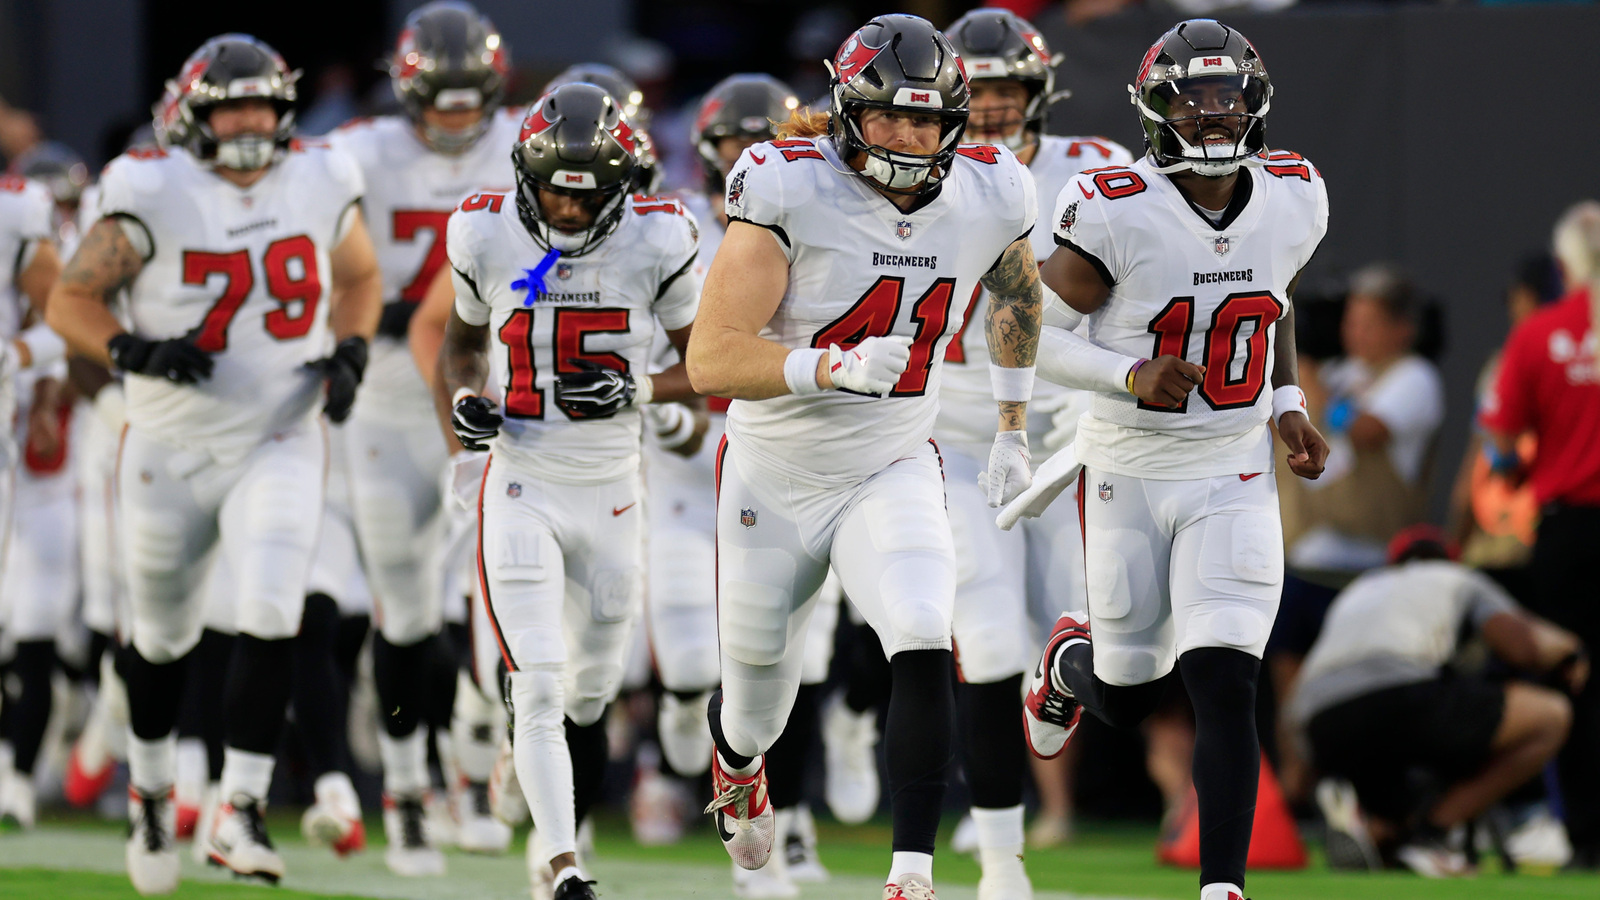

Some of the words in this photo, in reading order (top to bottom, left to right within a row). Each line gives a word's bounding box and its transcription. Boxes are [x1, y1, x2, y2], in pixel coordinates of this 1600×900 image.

[183, 233, 322, 353] 79
[872, 251, 937, 270] BUCCANEERS
[1193, 268, 1253, 286] BUCCANEERS
[498, 307, 630, 421] 15
[811, 275, 957, 398] 41
[1137, 290, 1283, 413] 10
